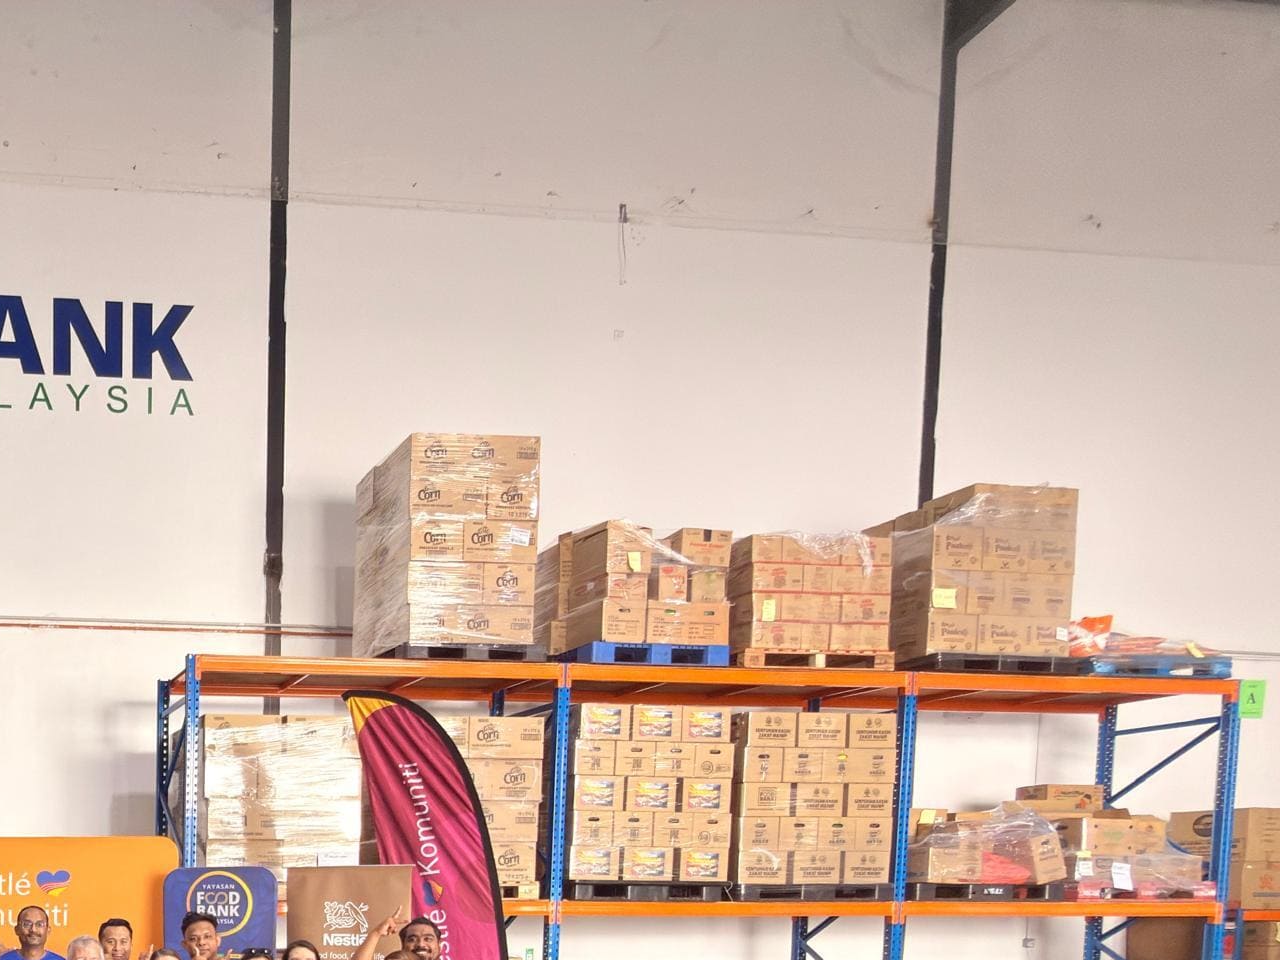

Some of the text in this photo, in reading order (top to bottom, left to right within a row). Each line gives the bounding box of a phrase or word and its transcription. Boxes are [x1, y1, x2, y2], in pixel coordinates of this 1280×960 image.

[418, 489, 440, 501] Corn
[500, 491, 523, 504] Corn
[471, 531, 494, 545] Corn
[467, 618, 489, 630] Corn
[1246, 692, 1256, 704] A
[476, 729, 499, 742] Corn
[504, 772, 526, 785] Corn
[399, 762, 440, 876] Komuniti
[498, 853, 520, 866] Corn
[196, 891, 240, 904] FOOD
[196, 905, 240, 918] BANK
[329, 952, 349, 960] food,
